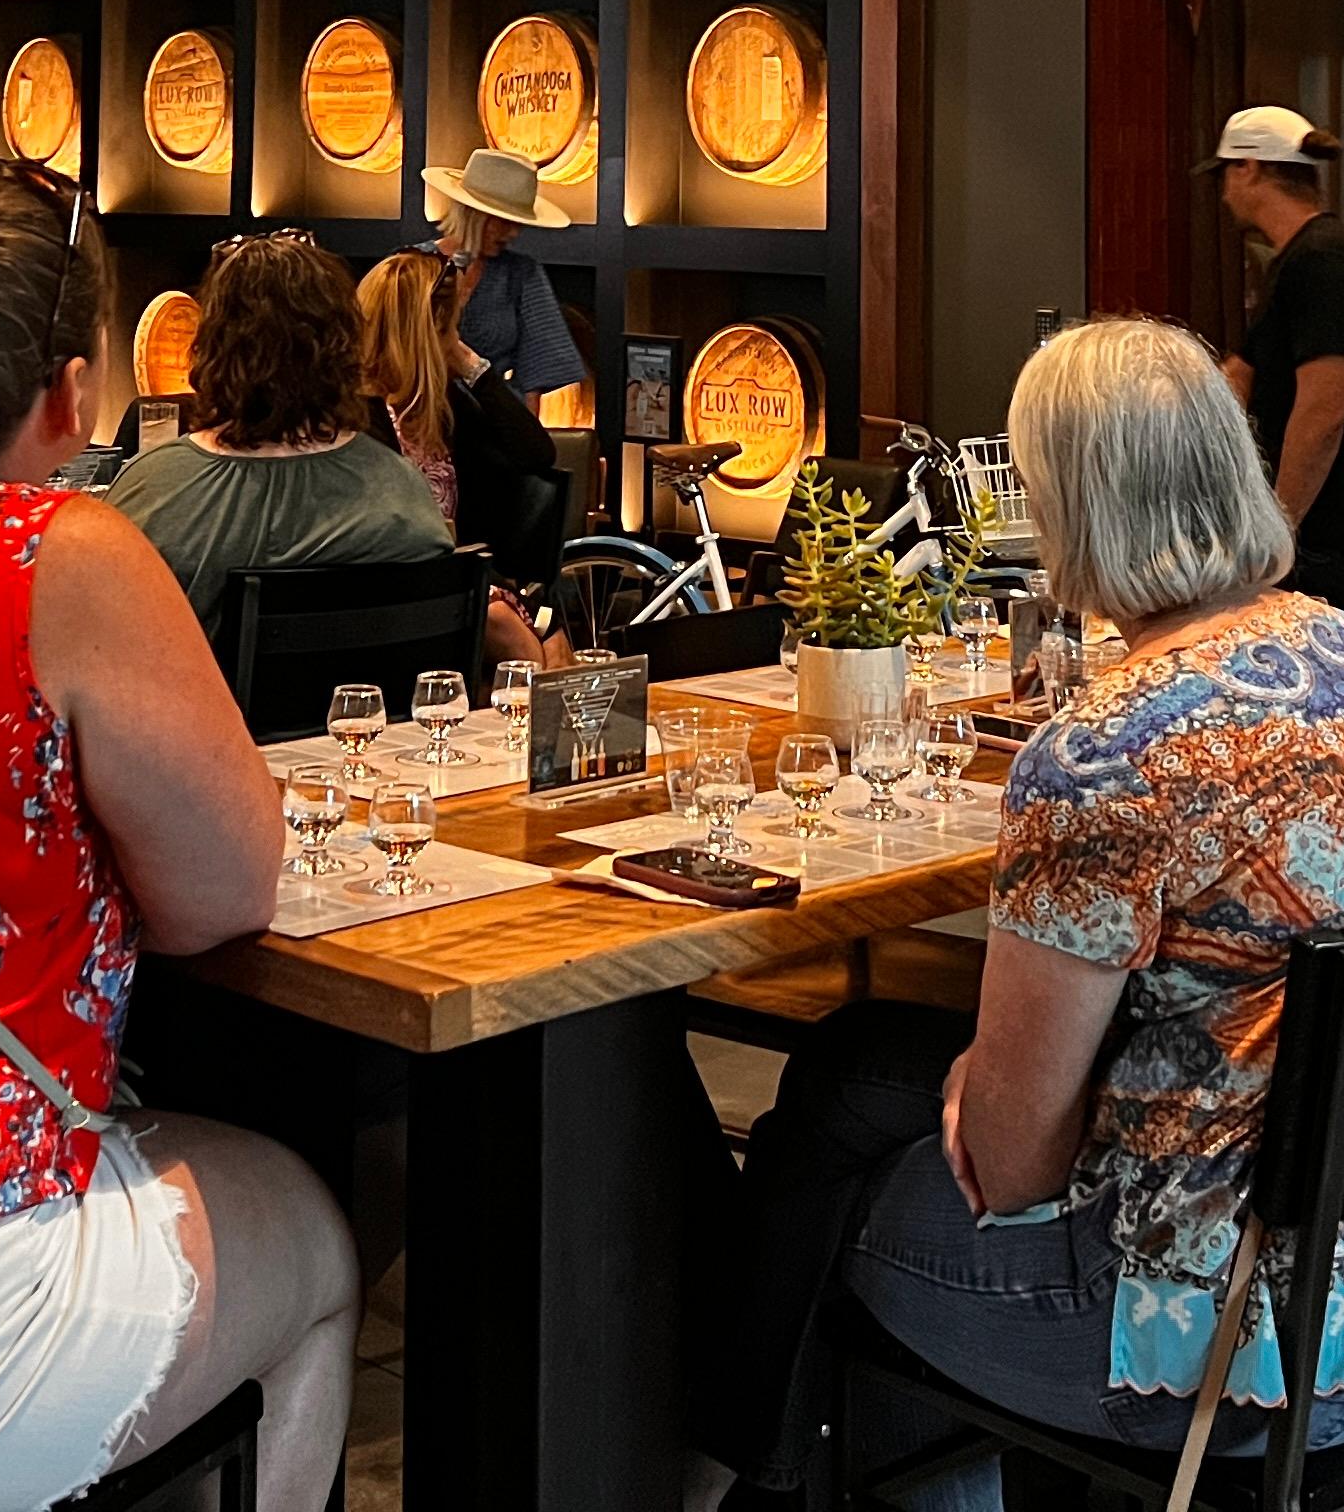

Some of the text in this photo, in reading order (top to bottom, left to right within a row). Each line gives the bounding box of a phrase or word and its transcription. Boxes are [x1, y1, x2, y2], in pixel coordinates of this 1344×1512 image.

[159, 85, 182, 105] LUX
[507, 93, 559, 120] WHISKEY
[706, 390, 787, 419] LUX ROW
